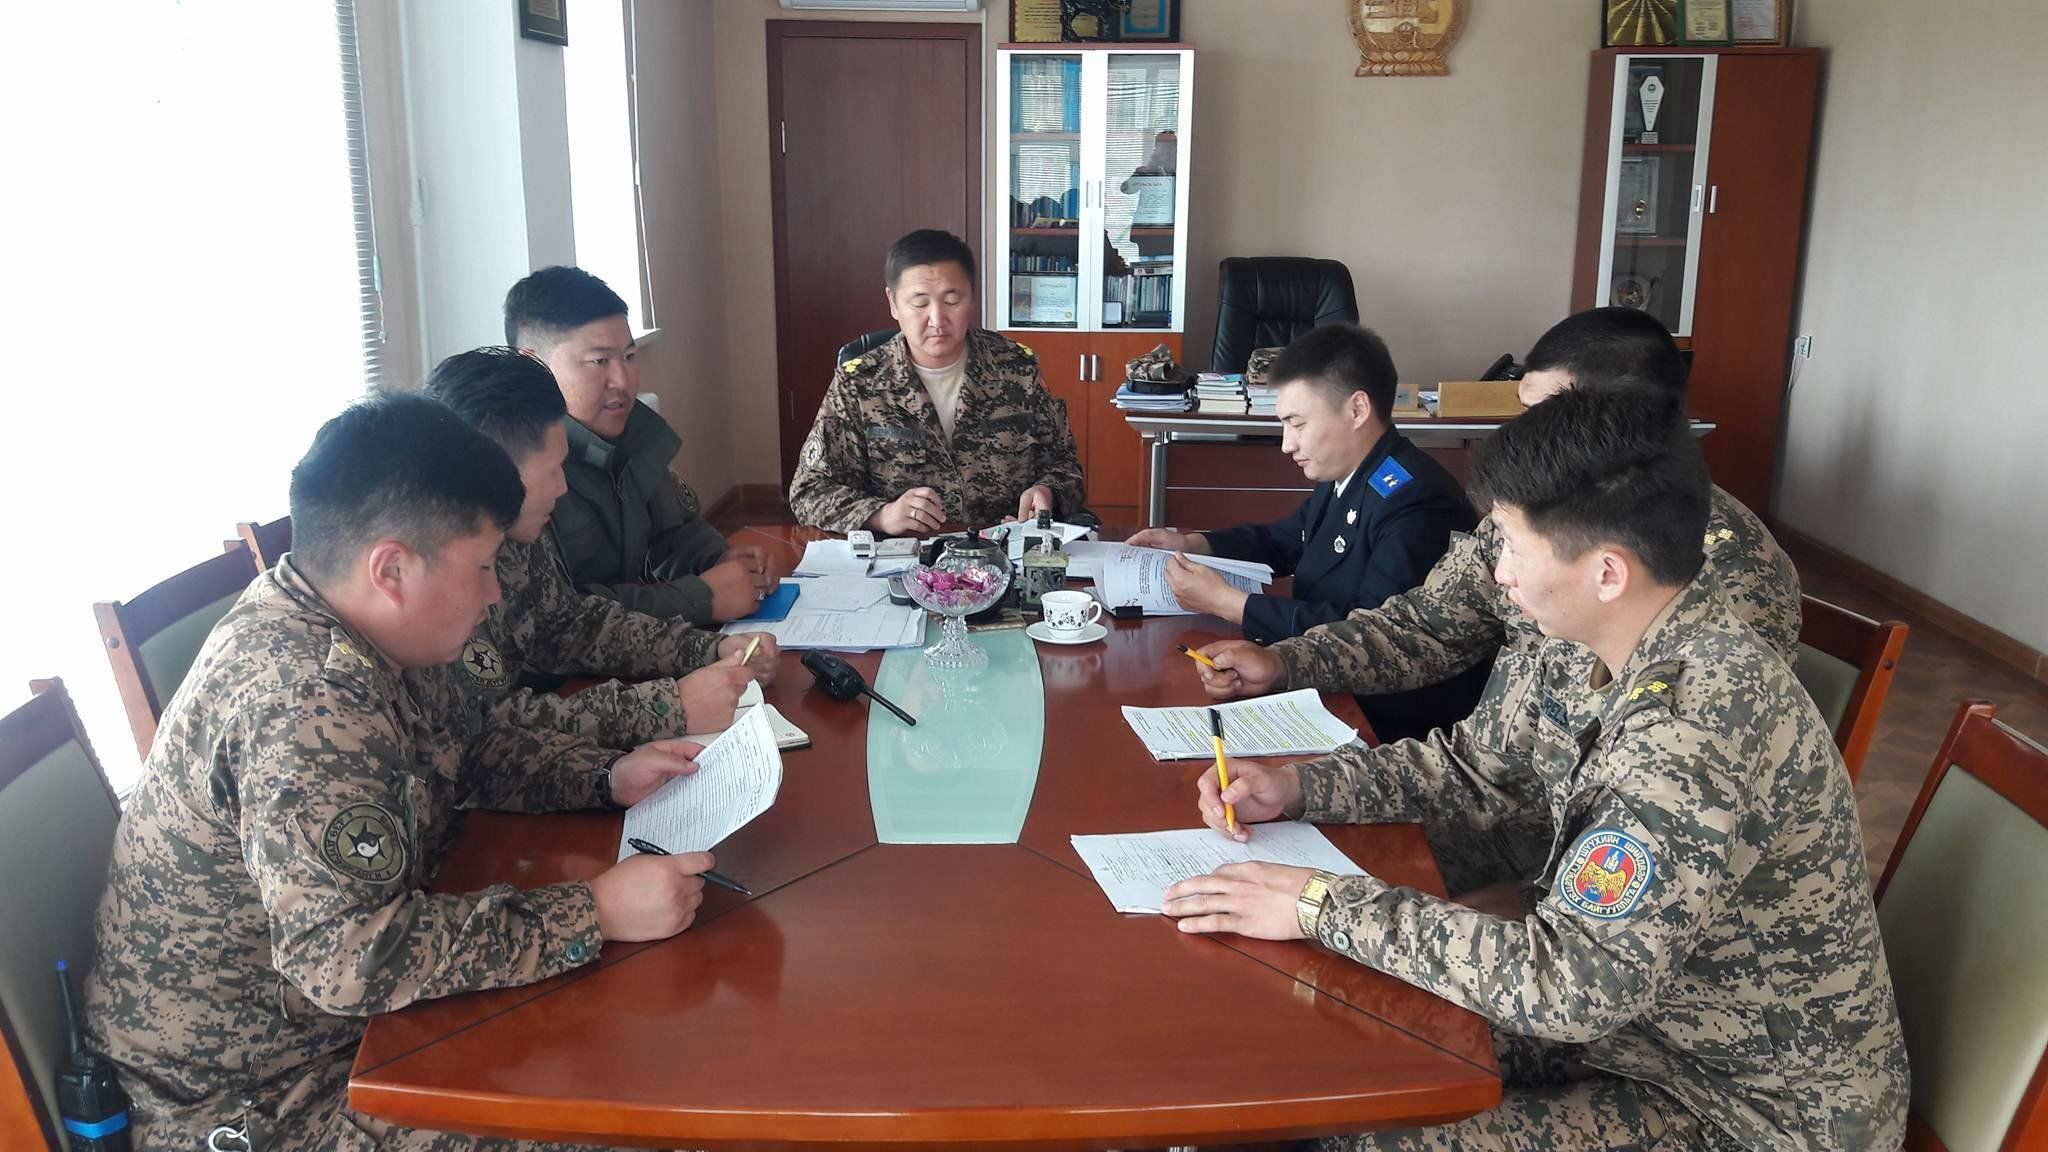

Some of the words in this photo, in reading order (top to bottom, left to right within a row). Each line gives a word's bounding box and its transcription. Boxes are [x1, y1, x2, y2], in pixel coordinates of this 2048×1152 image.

[1580, 835, 1620, 860] ШҮҮХИЙН
[1624, 841, 1647, 882] ШИЙДВЭР
[1581, 888, 1636, 914] БАЙГУУЛЛАГА
